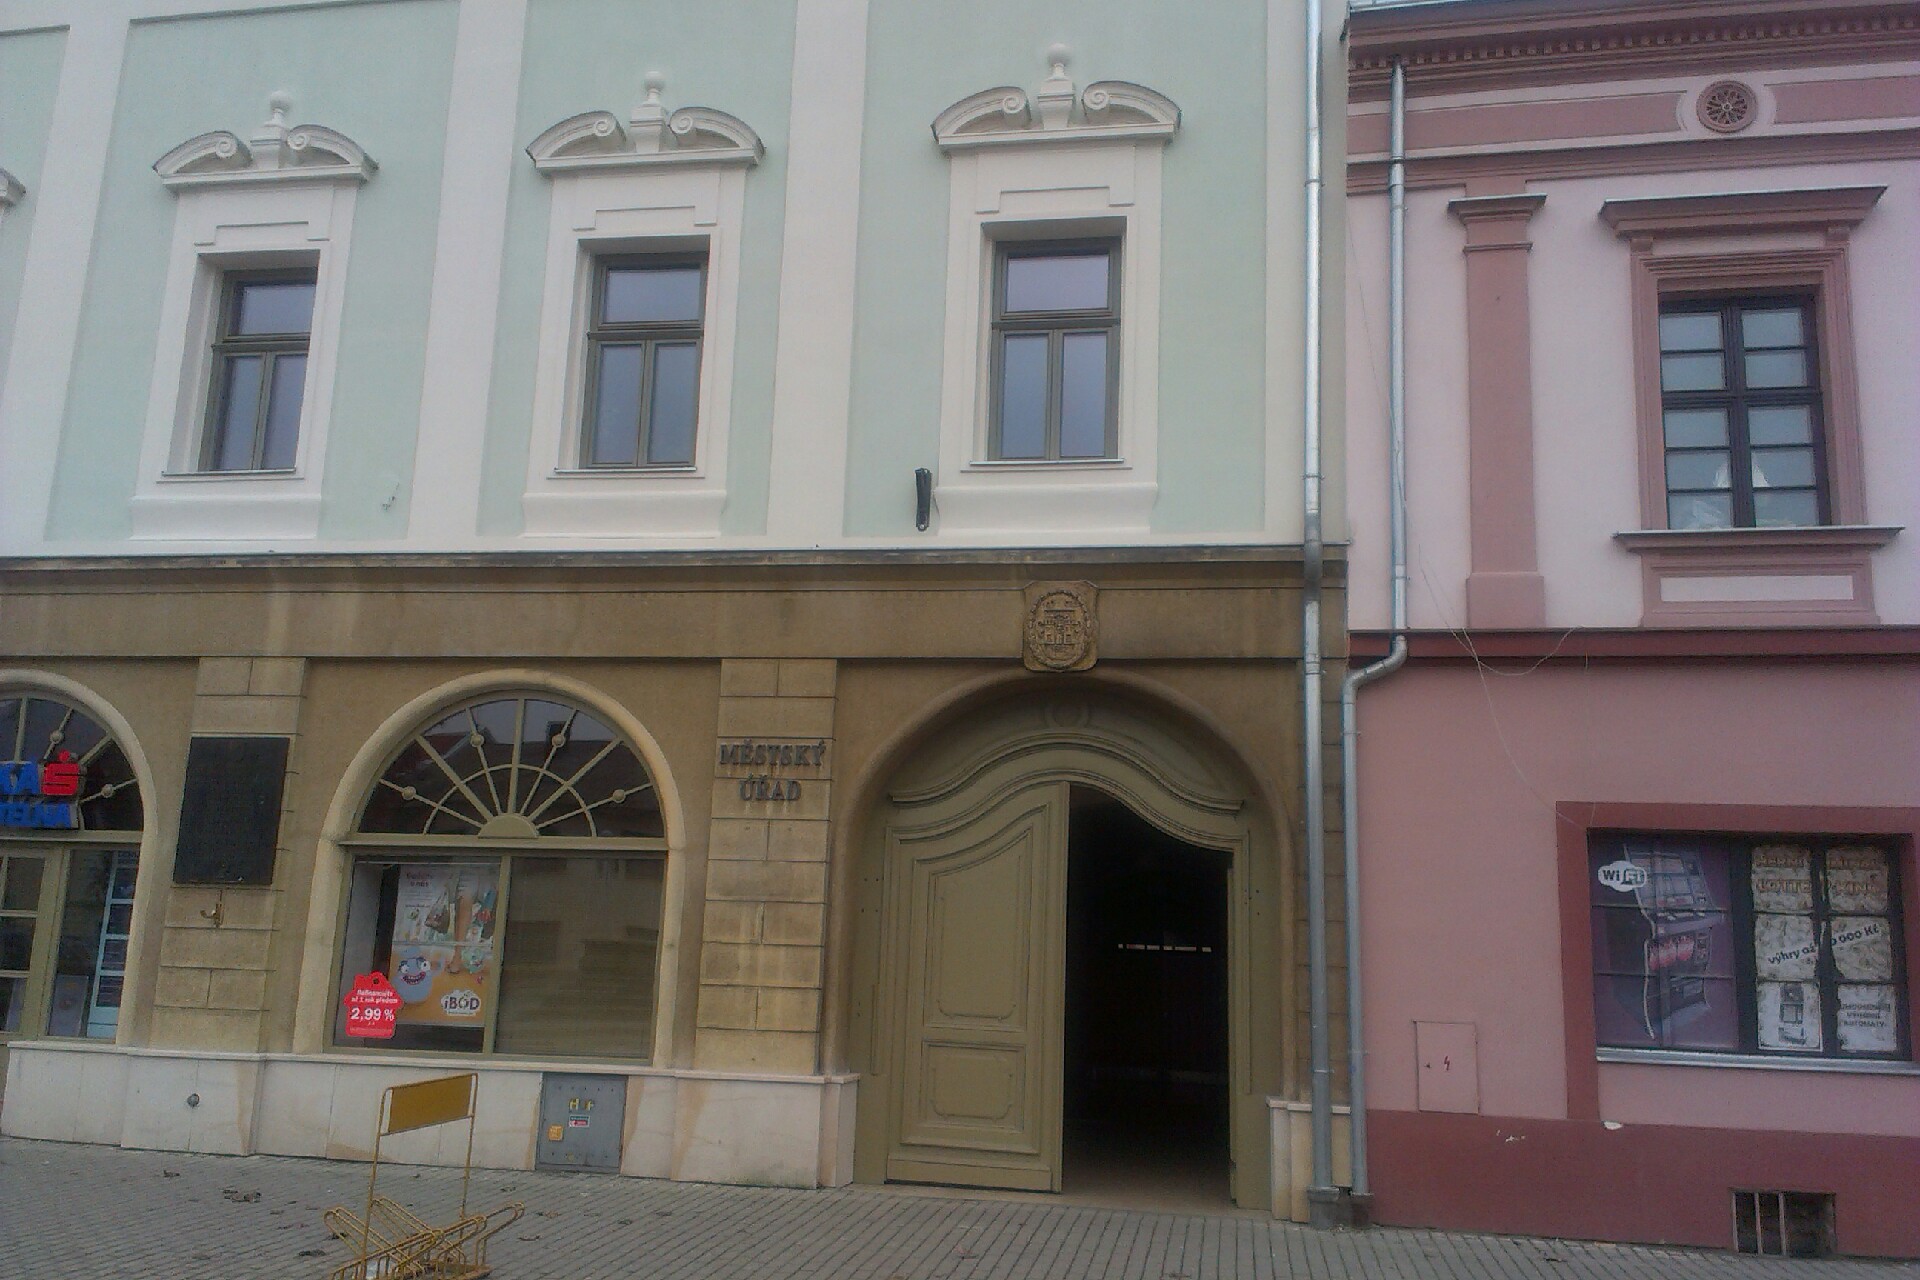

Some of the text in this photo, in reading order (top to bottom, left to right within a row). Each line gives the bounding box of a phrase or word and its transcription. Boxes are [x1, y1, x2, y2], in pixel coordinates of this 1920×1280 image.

[719, 738, 828, 766] MĚSTSKÝ
[737, 772, 802, 801] ÚŘAD
[1767, 949, 1801, 965] výhry
[1838, 930, 1862, 943] 000
[350, 1007, 395, 1022] 2,99 %
